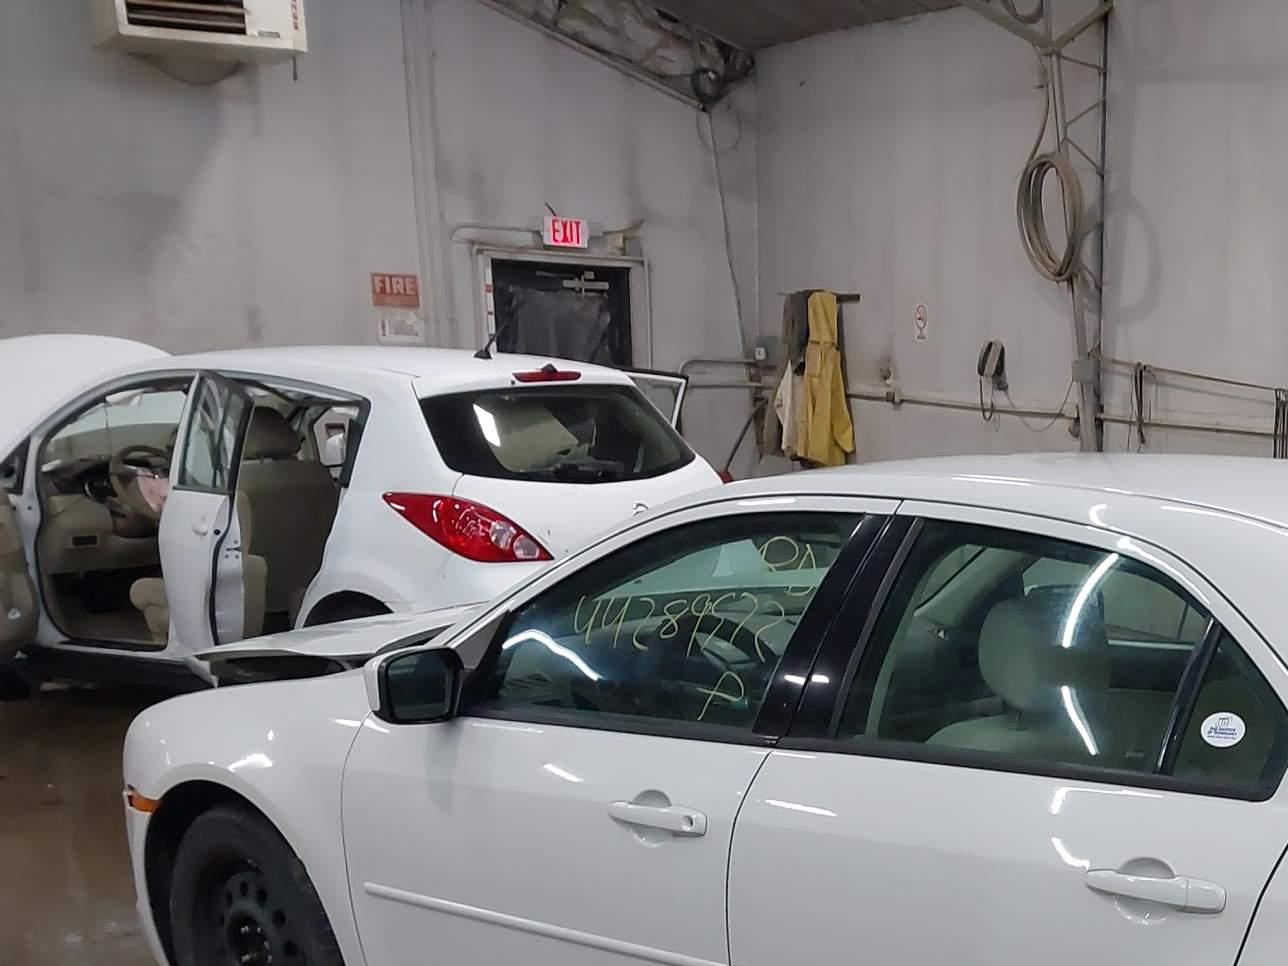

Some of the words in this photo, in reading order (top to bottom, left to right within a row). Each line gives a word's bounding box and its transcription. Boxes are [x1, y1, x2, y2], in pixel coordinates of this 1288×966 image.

[551, 219, 581, 245] EXIT
[373, 275, 417, 296] FIRE
[574, 591, 785, 662] 44289572
